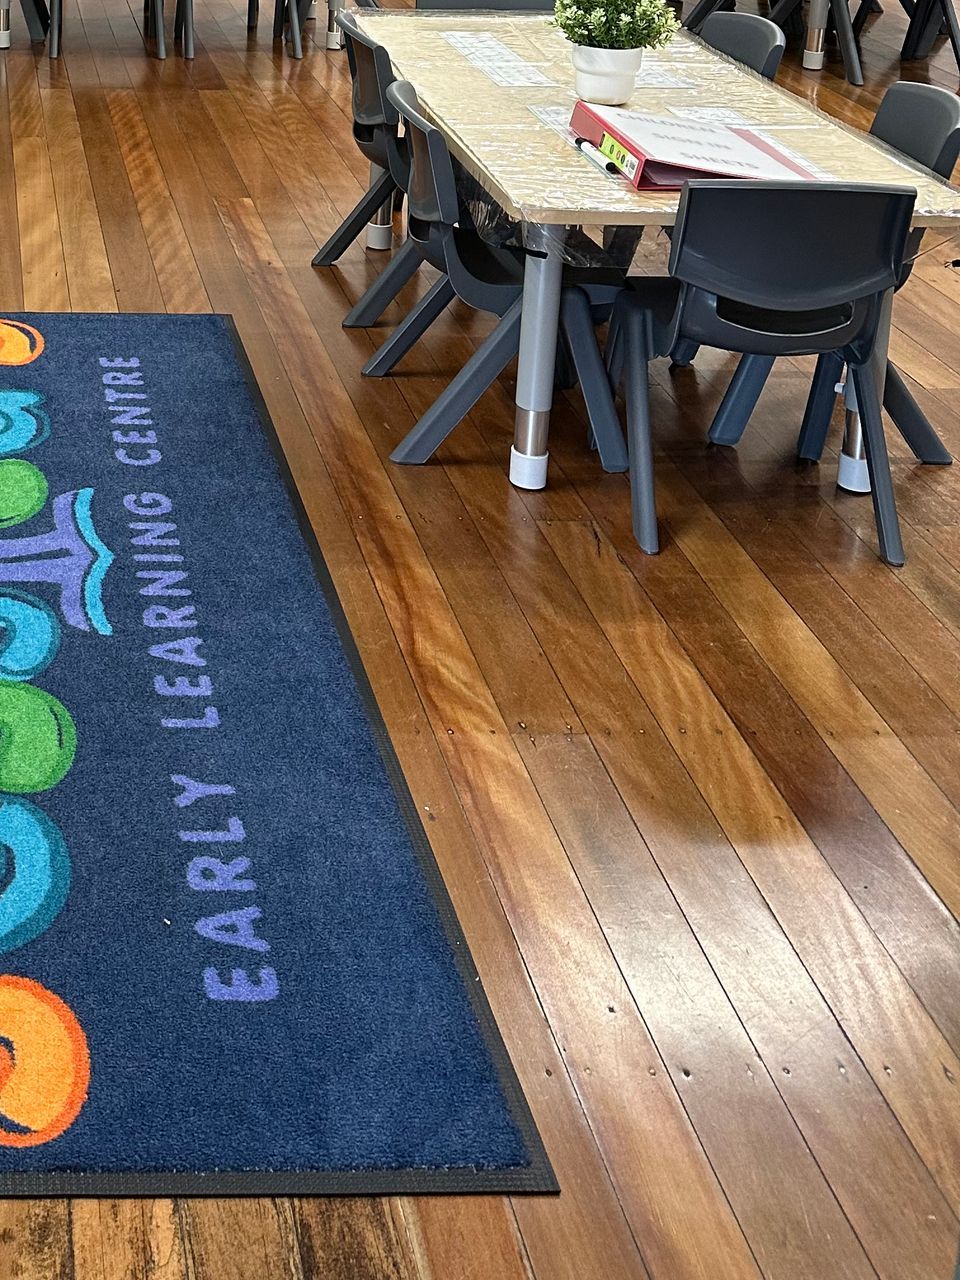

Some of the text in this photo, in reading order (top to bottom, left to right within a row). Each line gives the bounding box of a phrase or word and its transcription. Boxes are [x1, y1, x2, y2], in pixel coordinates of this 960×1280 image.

[99, 354, 280, 1003] EARLY LEARNING CENTRE
